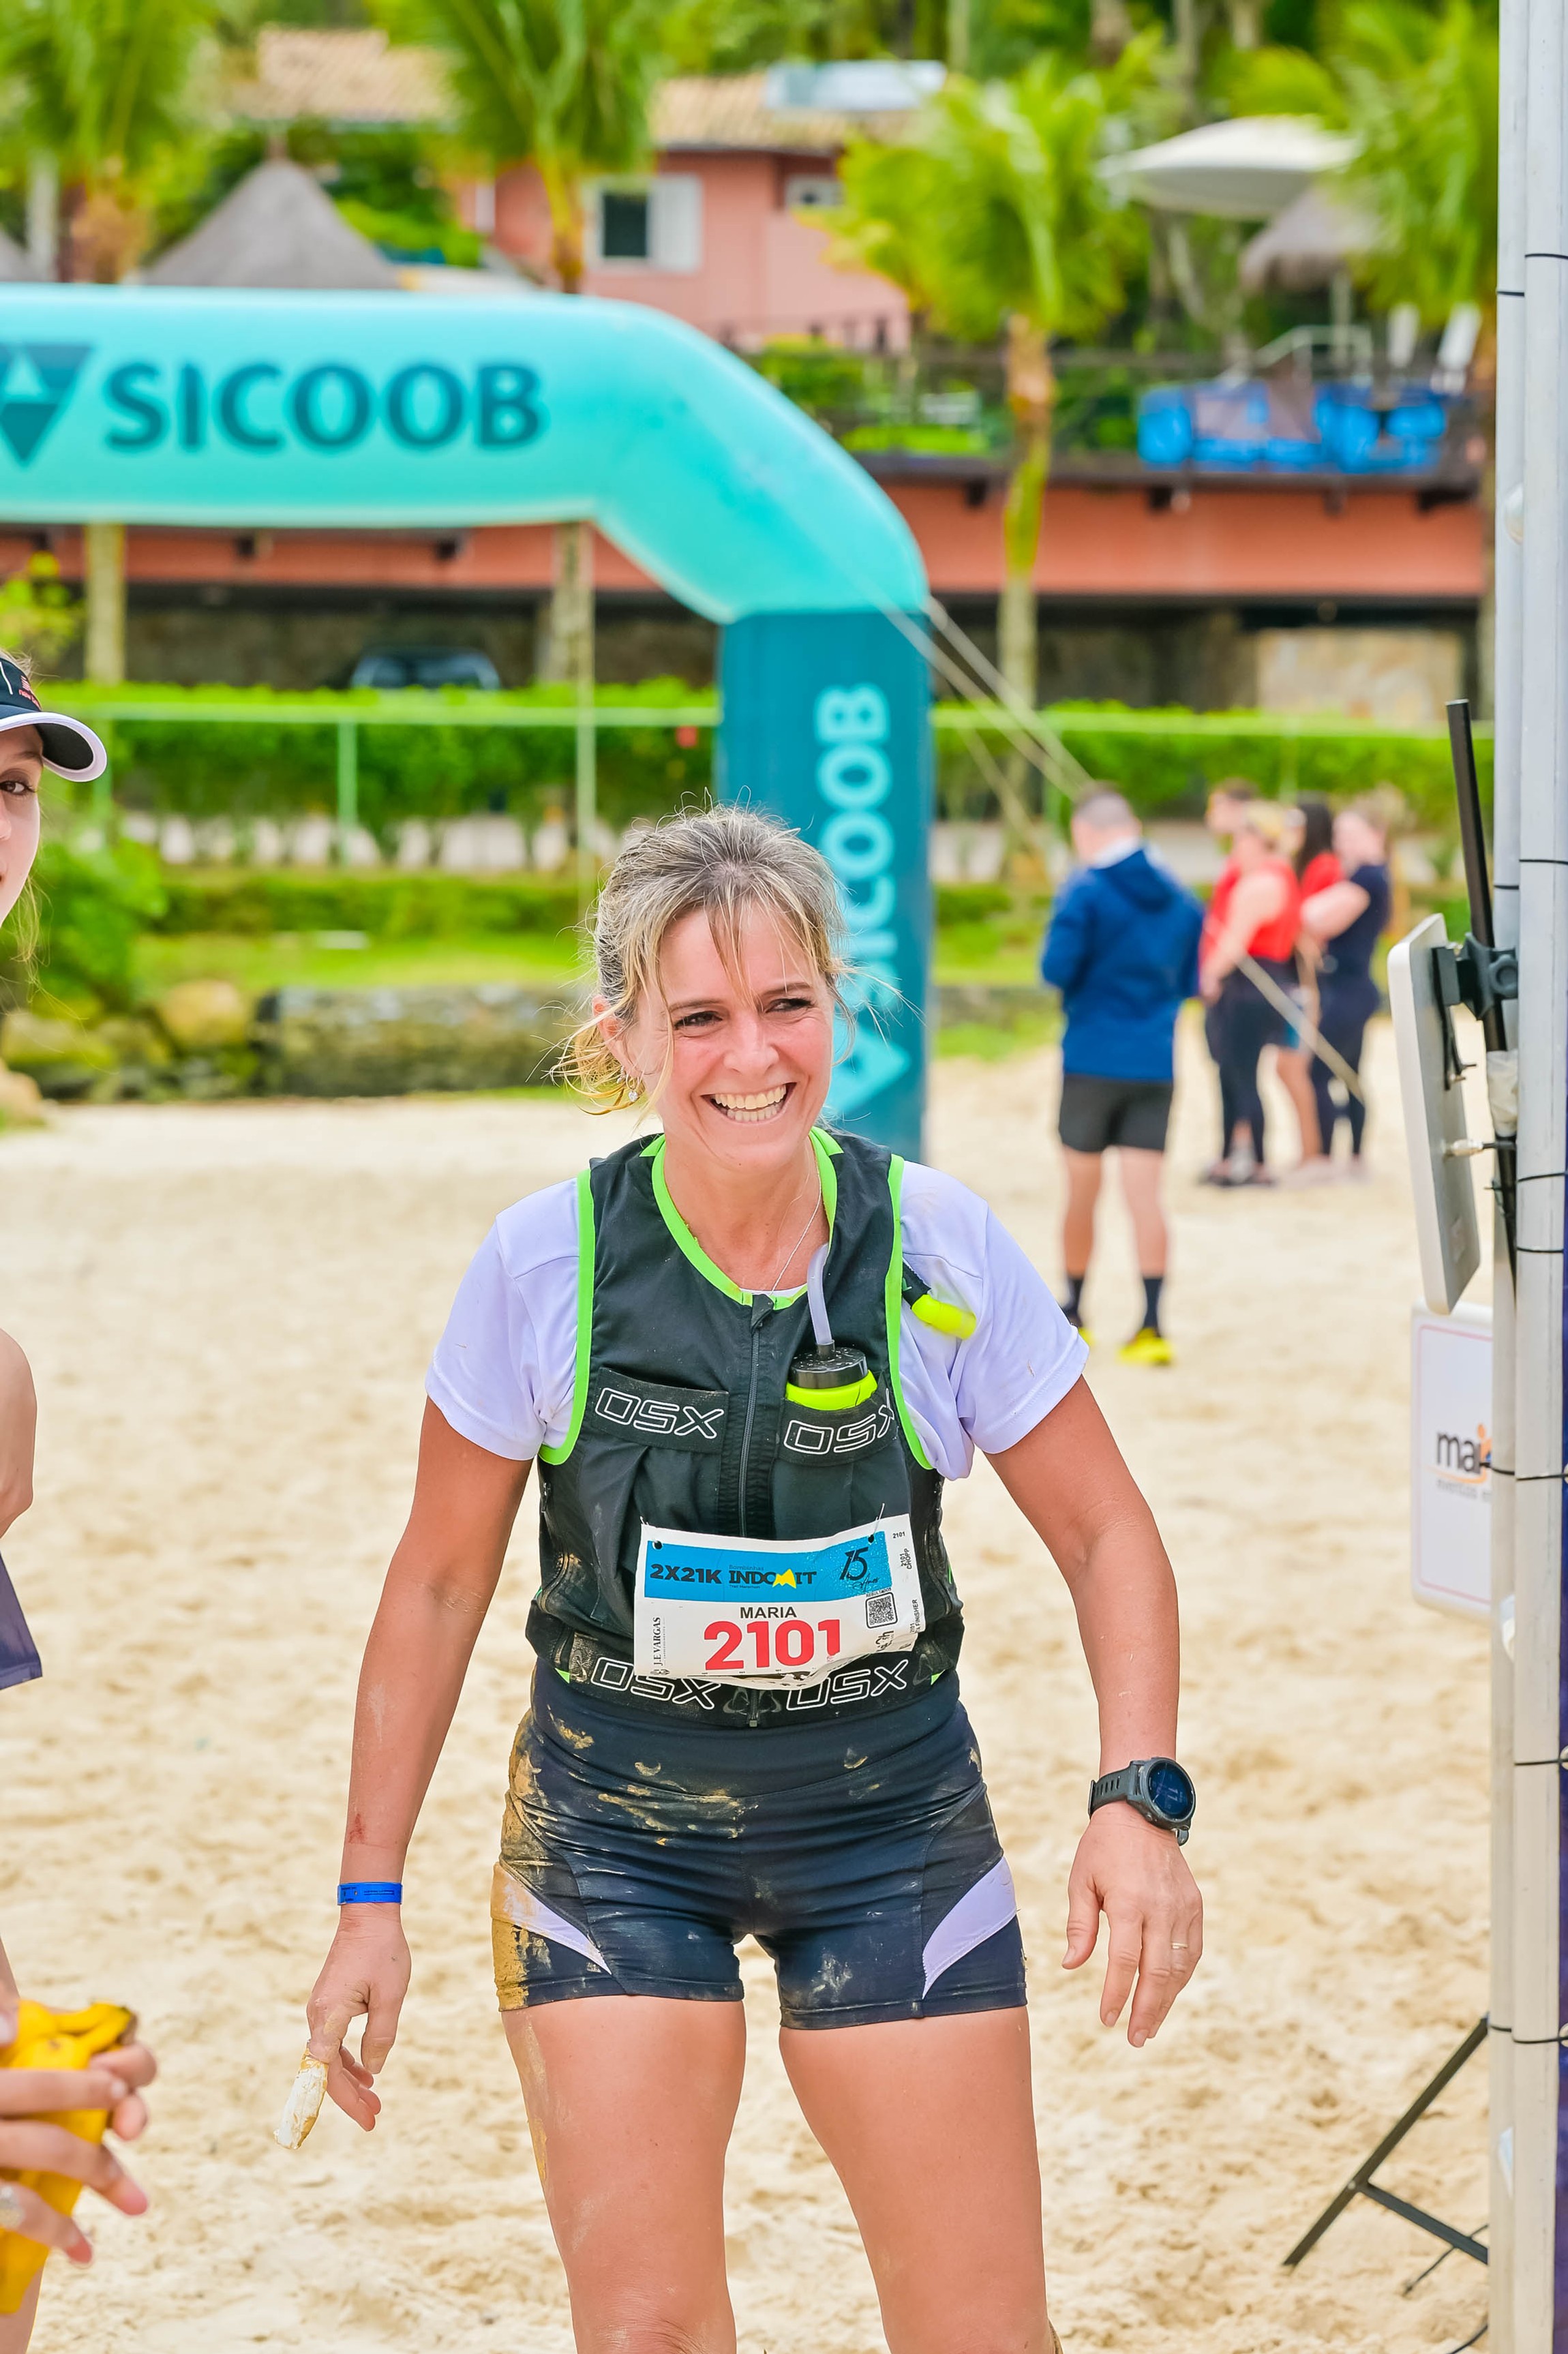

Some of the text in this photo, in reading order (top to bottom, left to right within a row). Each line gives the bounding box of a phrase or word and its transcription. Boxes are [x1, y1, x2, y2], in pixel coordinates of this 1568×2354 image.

[106, 360, 546, 453] SICOOB
[594, 1387, 724, 1438] OSX
[650, 1563, 722, 1584] 2X21K
[839, 1546, 869, 1581] 15
[904, 1548, 912, 1569] CHOPP
[729, 1569, 817, 1589] INDOMIT
[866, 1587, 892, 1598] RESULTADOS
[740, 1606, 797, 1618] MARIA
[652, 1617, 661, 1653] VARGAS
[704, 1619, 841, 1671] 2101
[590, 1657, 721, 1710] OSX
